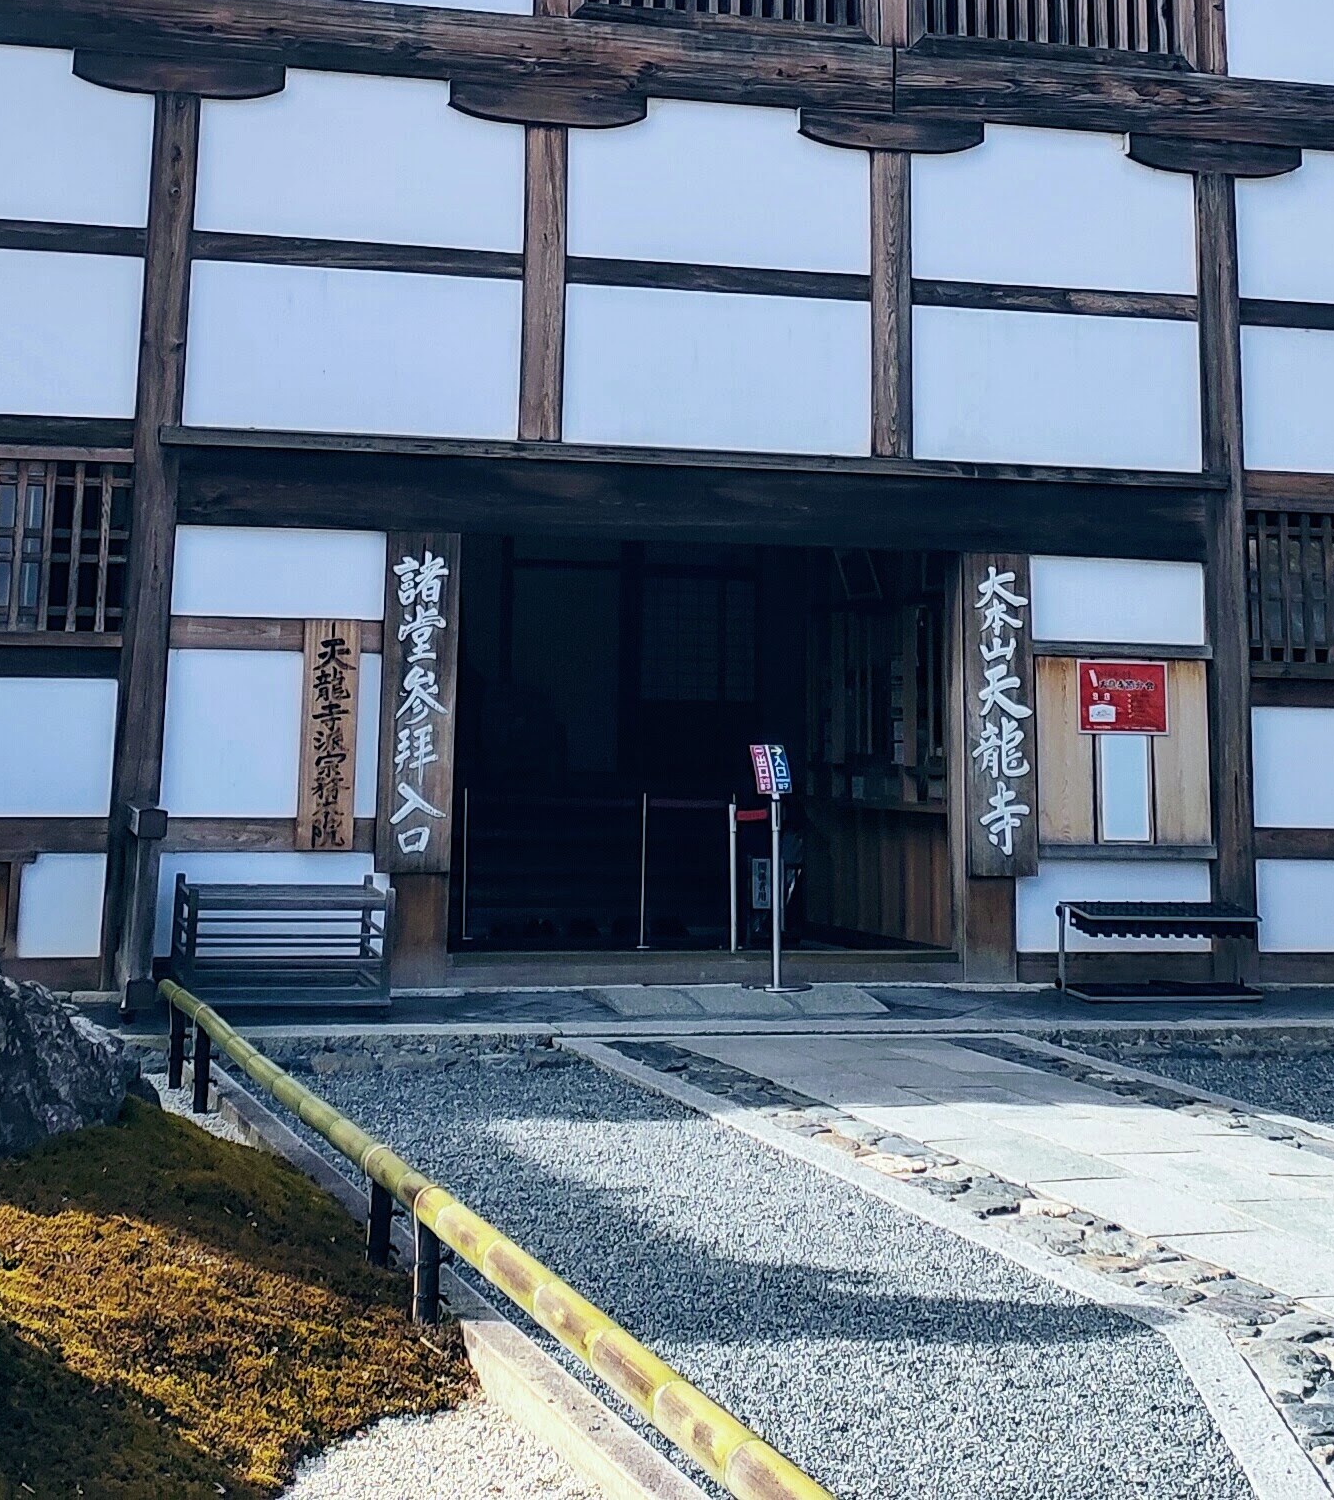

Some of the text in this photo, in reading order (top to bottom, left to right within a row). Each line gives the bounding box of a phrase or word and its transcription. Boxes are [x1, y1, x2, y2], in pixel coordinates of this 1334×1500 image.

[971, 565, 1033, 856] 大本山天龍寺
[755, 755, 770, 778] 出口
[774, 755, 788, 778] 入口
